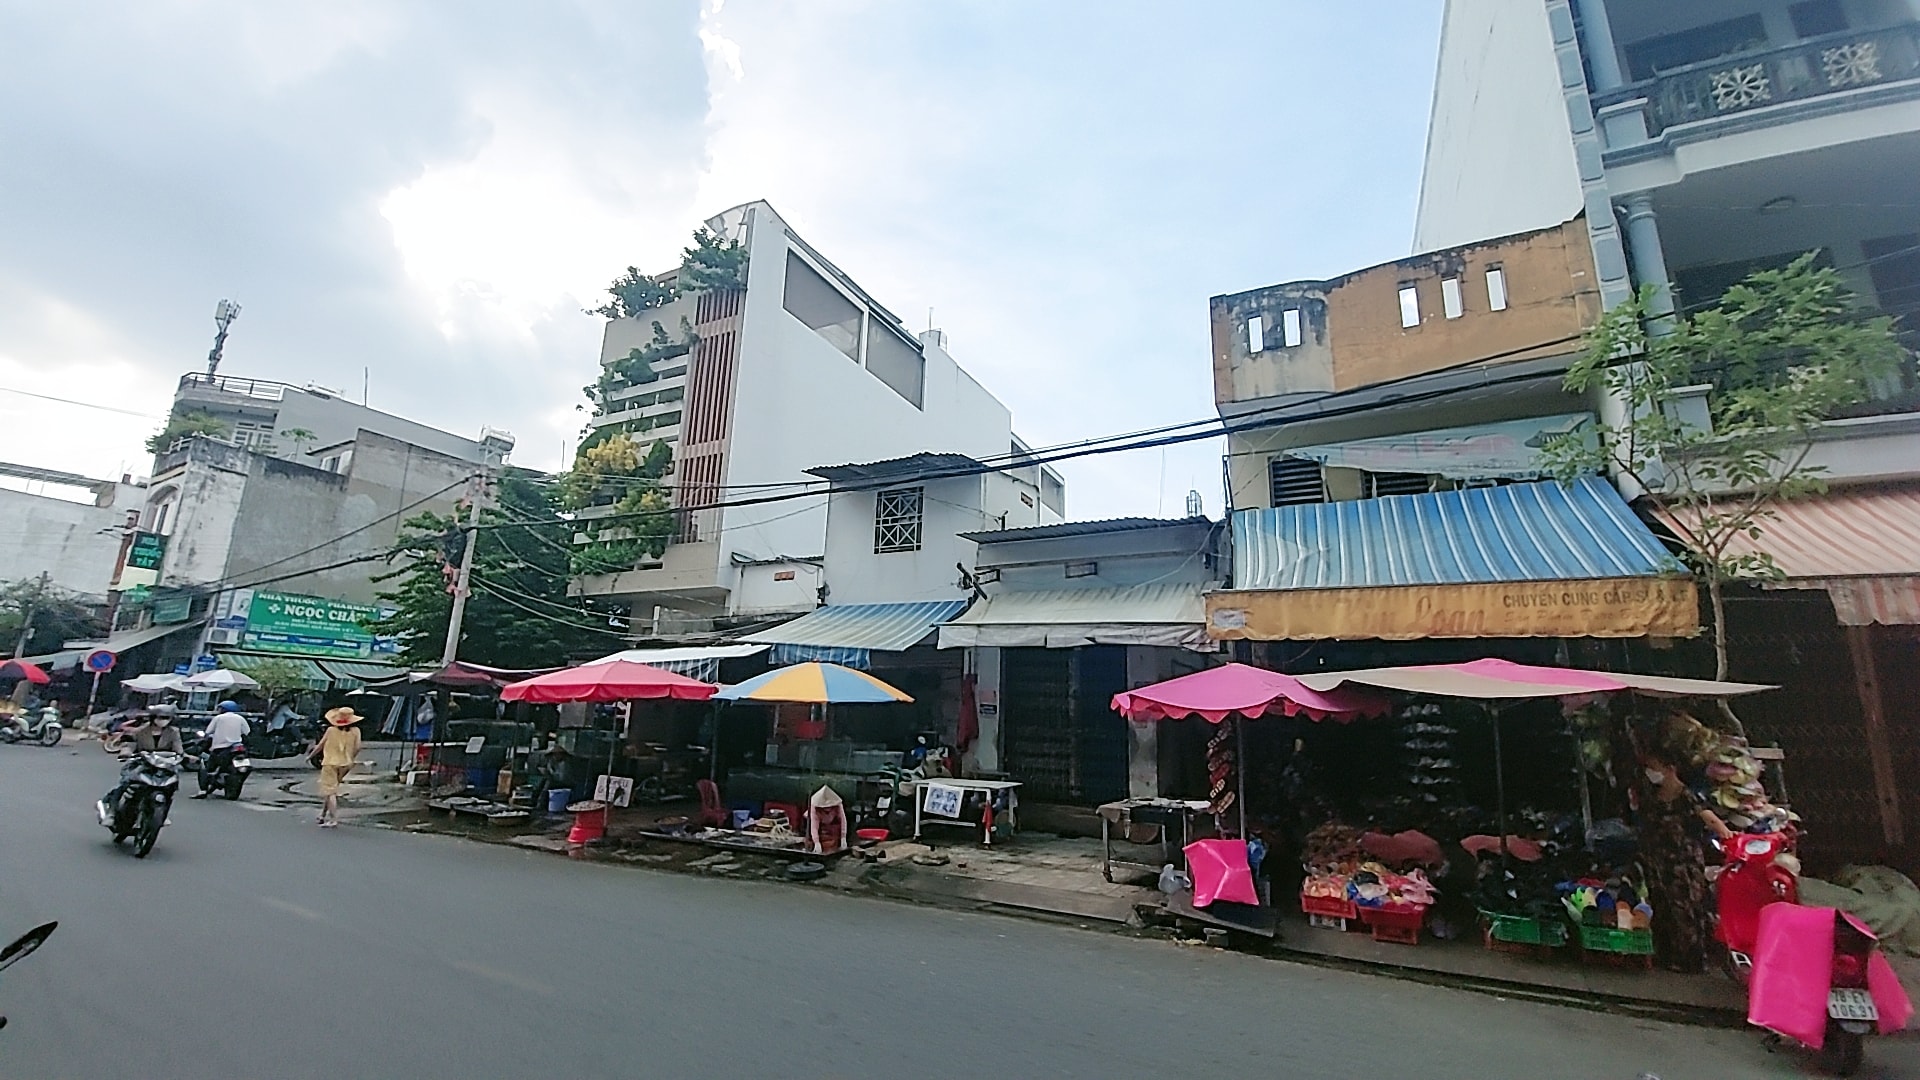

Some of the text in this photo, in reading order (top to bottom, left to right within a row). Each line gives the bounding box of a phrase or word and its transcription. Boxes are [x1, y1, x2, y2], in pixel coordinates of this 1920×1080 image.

[1562, 592, 1598, 606] CUNG
[284, 604, 325, 621] NGỌC
[327, 601, 378, 613] PHARMACY
